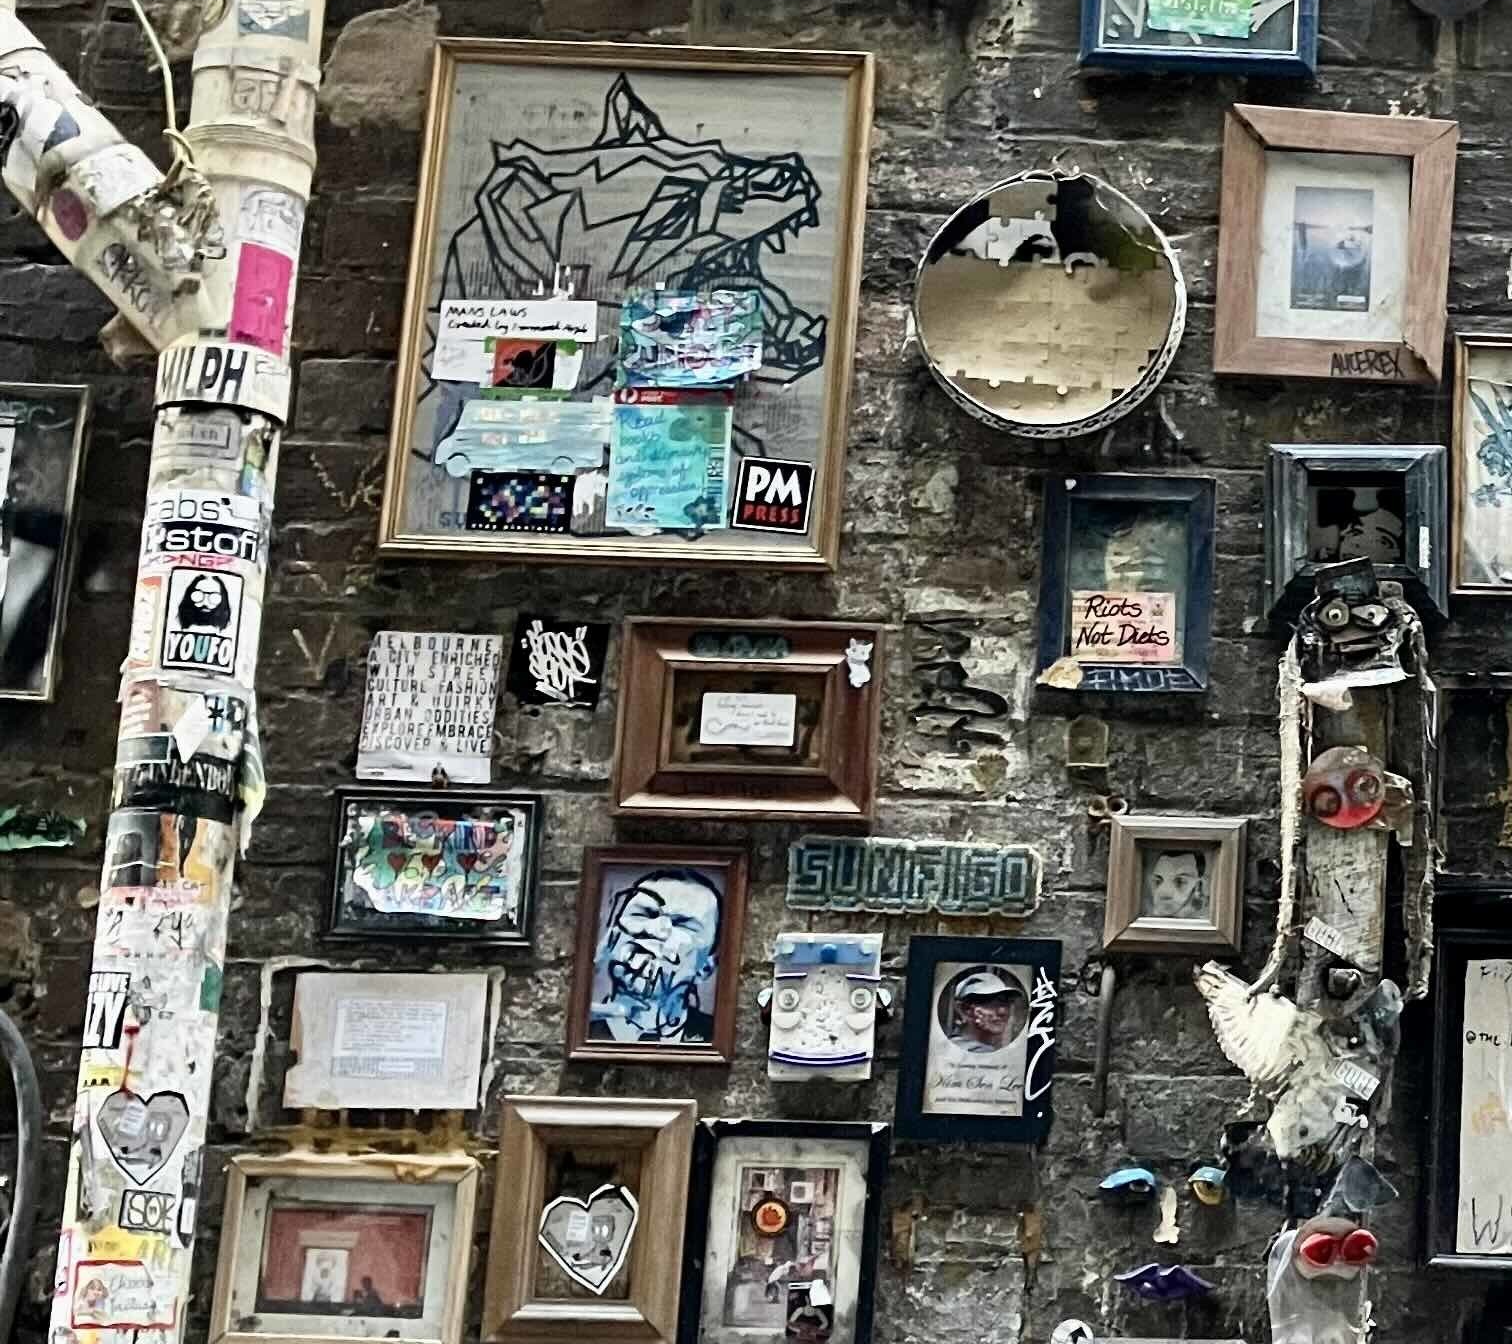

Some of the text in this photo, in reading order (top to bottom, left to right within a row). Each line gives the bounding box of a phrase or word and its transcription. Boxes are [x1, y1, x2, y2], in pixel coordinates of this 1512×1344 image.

[745, 465, 803, 507] PM
[743, 504, 801, 525] PRESS
[1084, 594, 1143, 619] Riots
[168, 632, 235, 667] YOUFO
[1076, 623, 1170, 651] Not Diets
[438, 680, 498, 696] FASHION
[456, 738, 488, 754] LIVE
